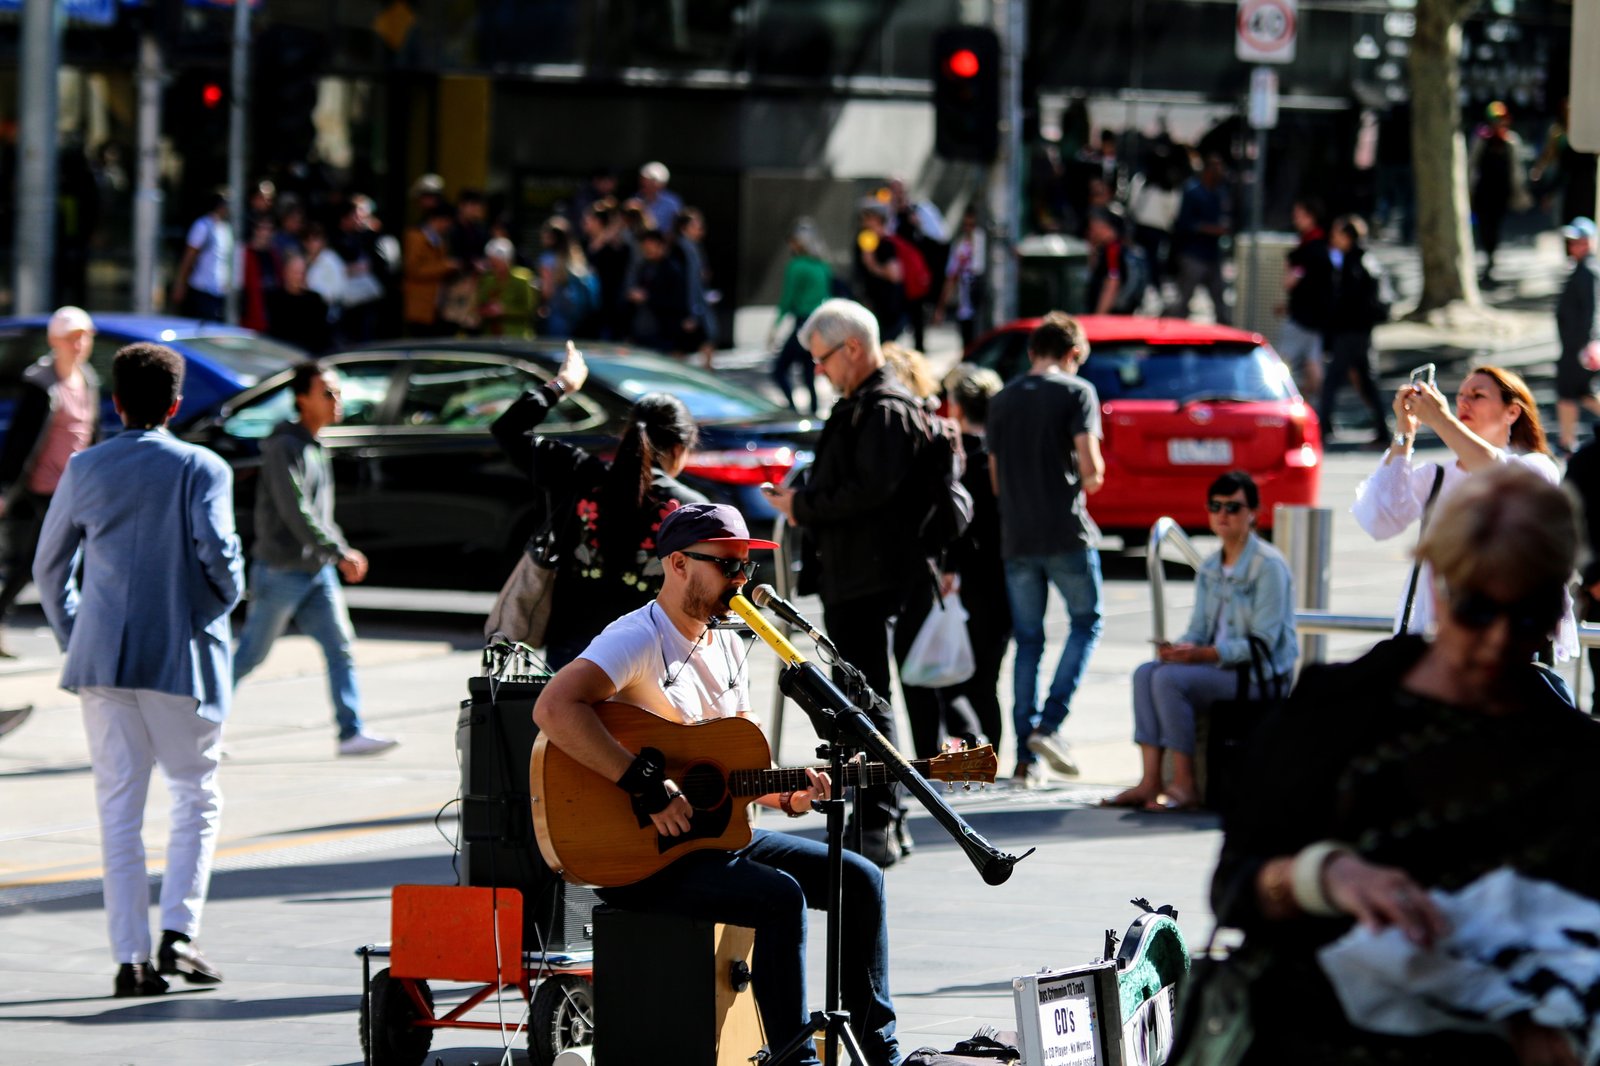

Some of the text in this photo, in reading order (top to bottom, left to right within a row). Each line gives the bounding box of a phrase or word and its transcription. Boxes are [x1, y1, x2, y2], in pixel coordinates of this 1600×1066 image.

[1072, 980, 1086, 995] Track
[1054, 1007, 1076, 1036] CD's
[1055, 1045, 1068, 1058] Player
[1076, 1040, 1092, 1053] Worries
